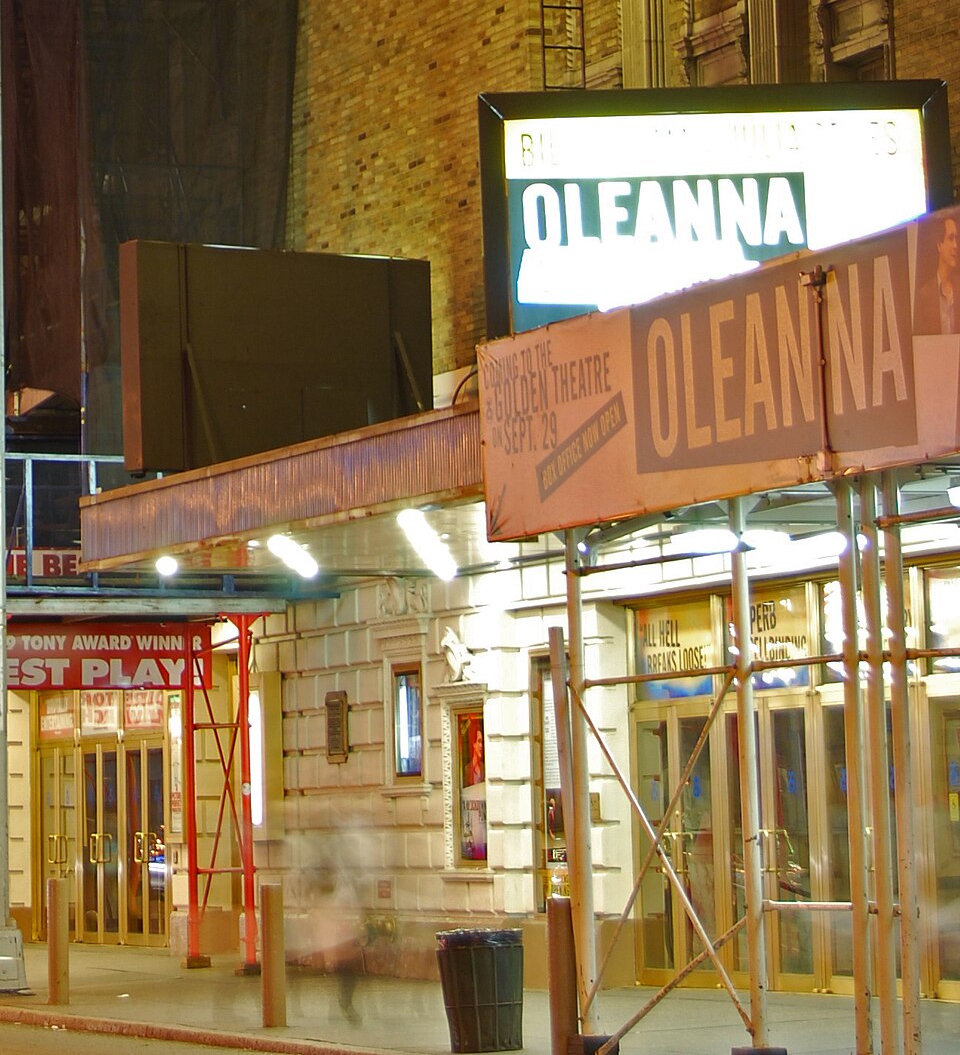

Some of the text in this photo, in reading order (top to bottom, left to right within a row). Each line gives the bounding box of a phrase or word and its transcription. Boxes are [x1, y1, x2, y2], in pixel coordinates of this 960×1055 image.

[522, 177, 805, 246] OLEANNA
[484, 340, 553, 390] COMING TO THE
[647, 255, 908, 459] OLEANNA
[494, 352, 611, 423] GOLDEN THEATRE
[504, 416, 537, 455] SEPT.
[541, 411, 558, 451] 29
[541, 401, 621, 490] BOX OFFICE NOW OPEN
[22, 634, 66, 651] TONY
[71, 634, 132, 651] AWARD
[137, 635, 203, 651] WINNR
[658, 619, 681, 648] HELL
[647, 649, 677, 674] BREAKS
